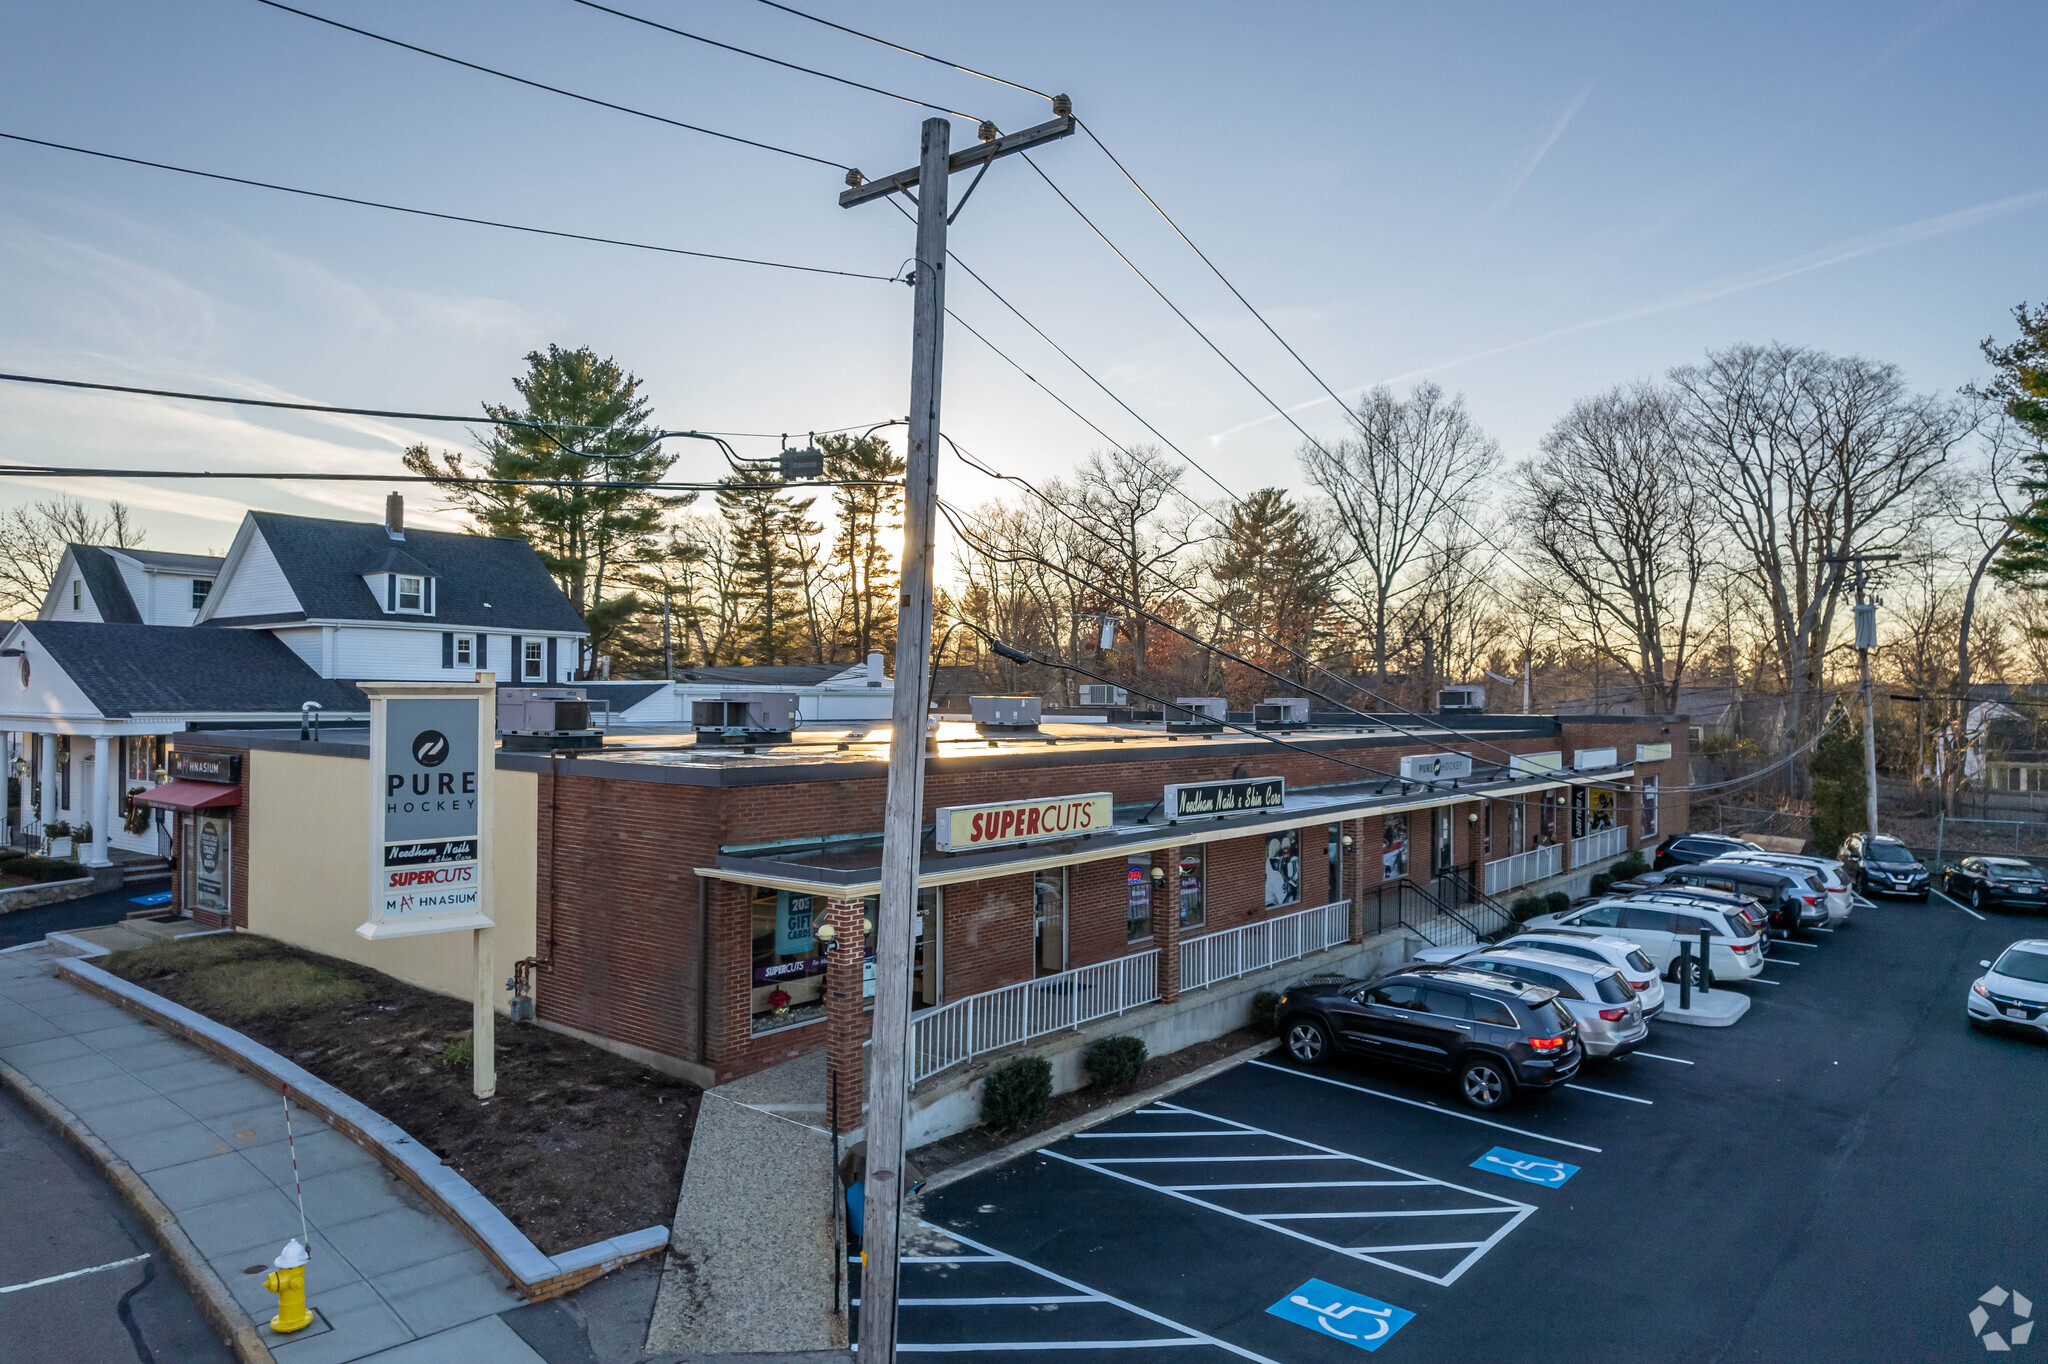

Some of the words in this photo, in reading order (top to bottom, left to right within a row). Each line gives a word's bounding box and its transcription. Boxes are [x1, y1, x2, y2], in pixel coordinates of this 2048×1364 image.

[387, 771, 475, 797] PURE
[387, 799, 475, 813] HOCKEY
[1179, 790, 1214, 813] Needham
[1215, 787, 1235, 810] Nails
[1245, 786, 1263, 808] Skin
[1265, 785, 1281, 806] Care
[970, 801, 1092, 842] SUPERCUTS
[388, 844, 437, 859] Needham
[443, 841, 471, 854] Nails
[434, 855, 452, 863] Skin
[389, 866, 473, 887] SUPERCUTS
[788, 914, 811, 931] GIFT
[787, 929, 811, 940] CARDS
[765, 961, 804, 977] SUPERCUTS
